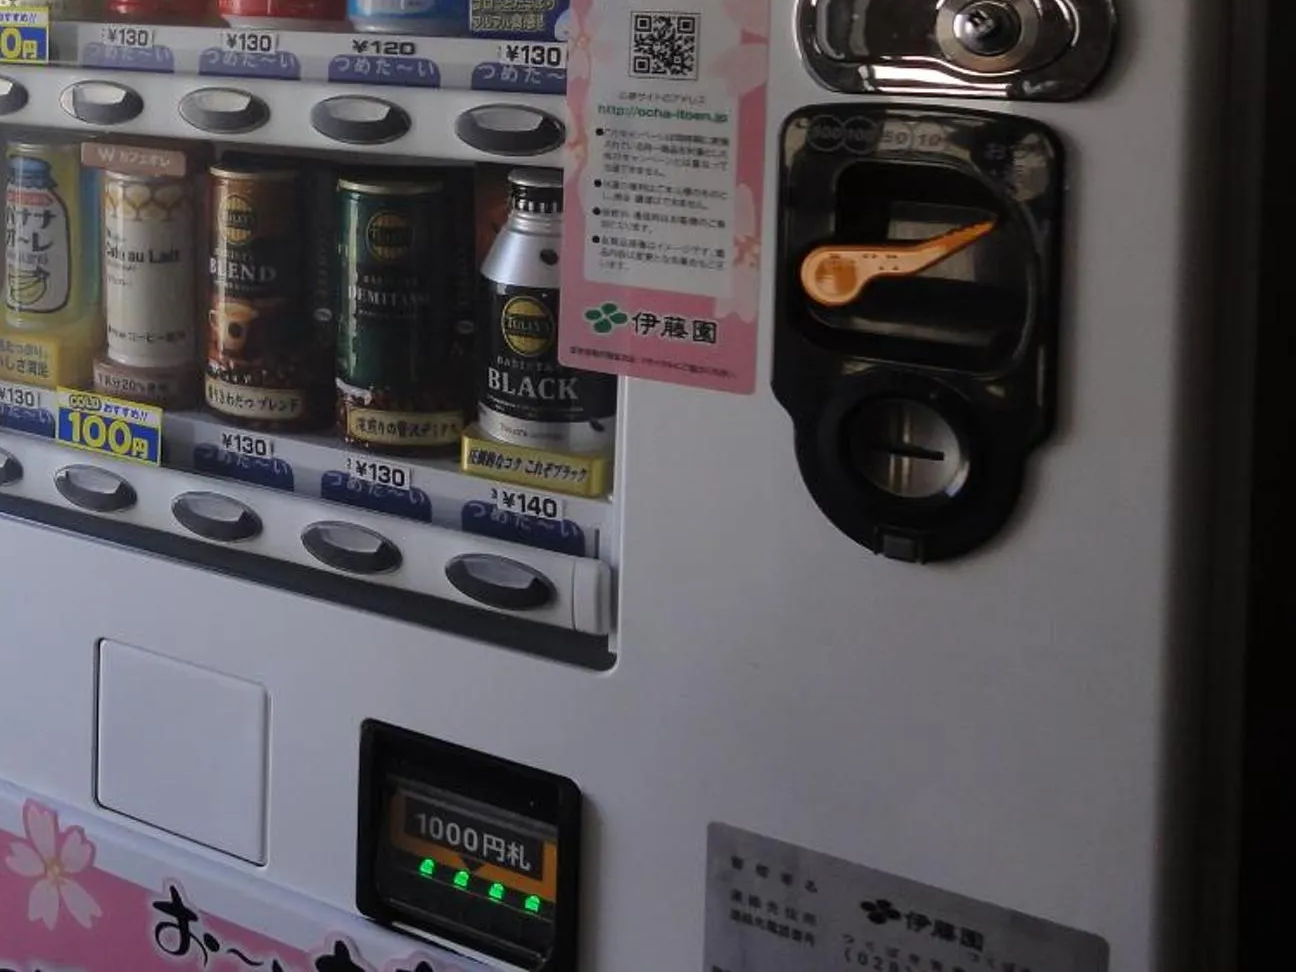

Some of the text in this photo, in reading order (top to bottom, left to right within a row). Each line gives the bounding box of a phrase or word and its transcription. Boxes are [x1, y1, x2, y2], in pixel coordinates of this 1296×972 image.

[107, 27, 149, 47] ¥130
[226, 33, 273, 53] ¥130
[352, 39, 418, 56] ¥120
[505, 44, 562, 67] ¥130
[632, 310, 718, 346] 伊藤園
[487, 365, 579, 401] BLACK
[68, 410, 149, 459] 100円
[222, 433, 267, 456] ¥130
[355, 463, 405, 487] ¥130
[501, 491, 558, 519] ¥140
[414, 812, 532, 871] 1000円札
[904, 910, 985, 952] 伊藤園
